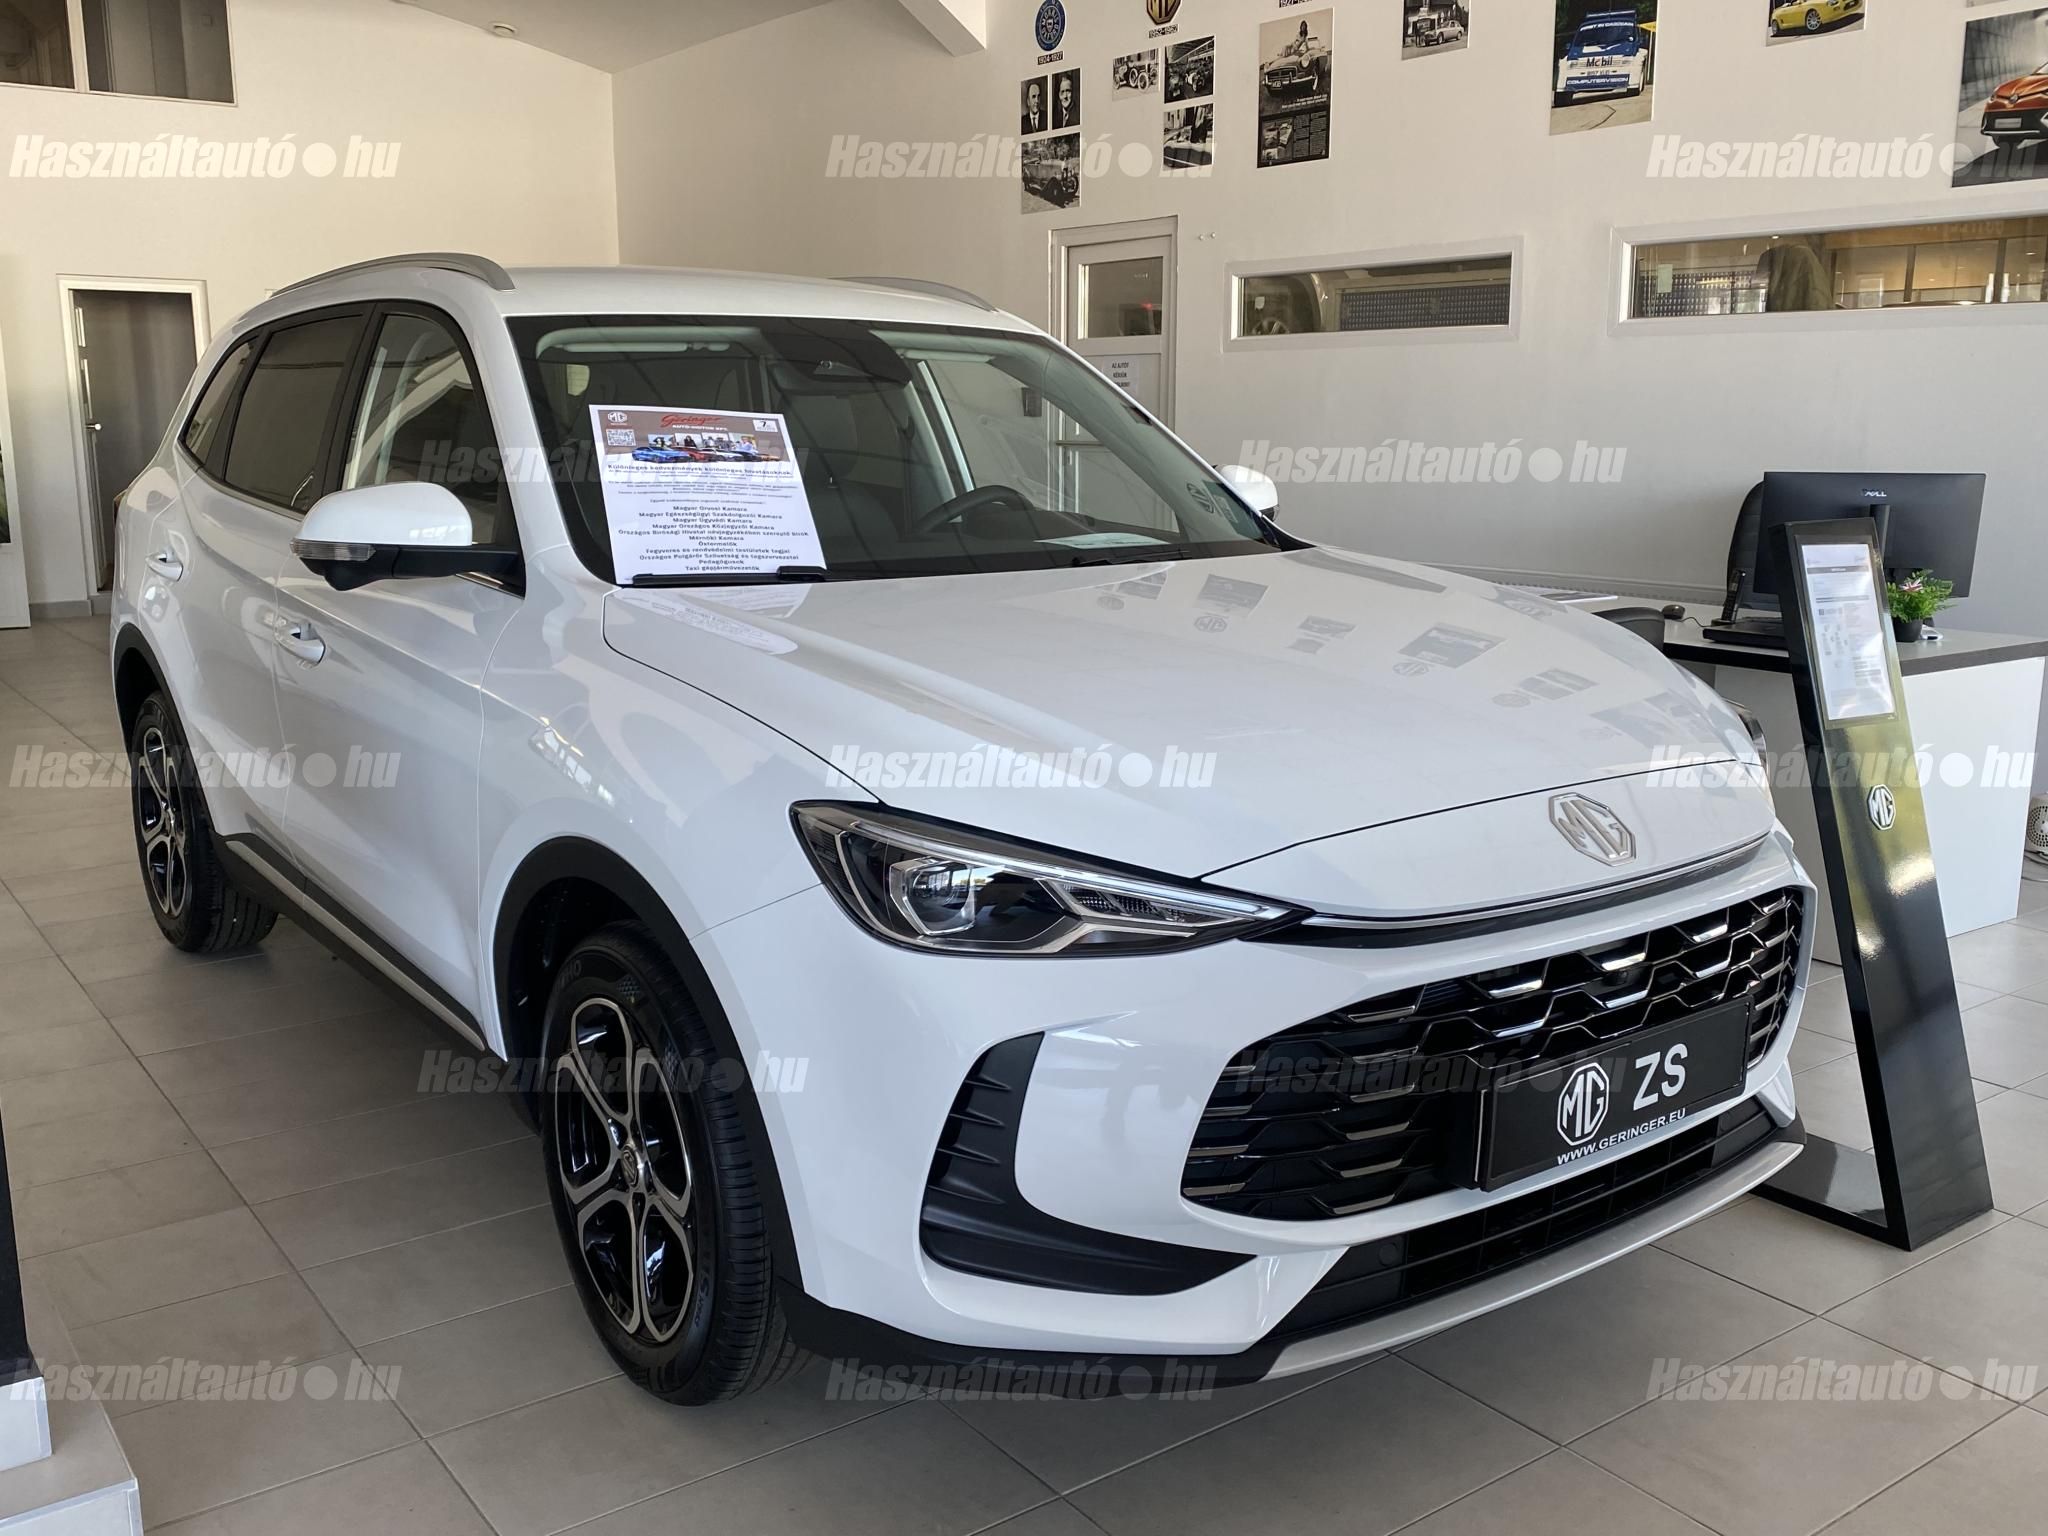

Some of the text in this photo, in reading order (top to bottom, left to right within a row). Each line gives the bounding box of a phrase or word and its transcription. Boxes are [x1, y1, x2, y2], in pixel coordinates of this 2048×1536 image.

[1551, 794, 1633, 863] MG
[1868, 785, 1896, 830] MG
[1558, 1063, 1609, 1145] MG
[1633, 1043, 1688, 1111] ZS
[1557, 1108, 1686, 1165] WWW.GERINGER.EU
